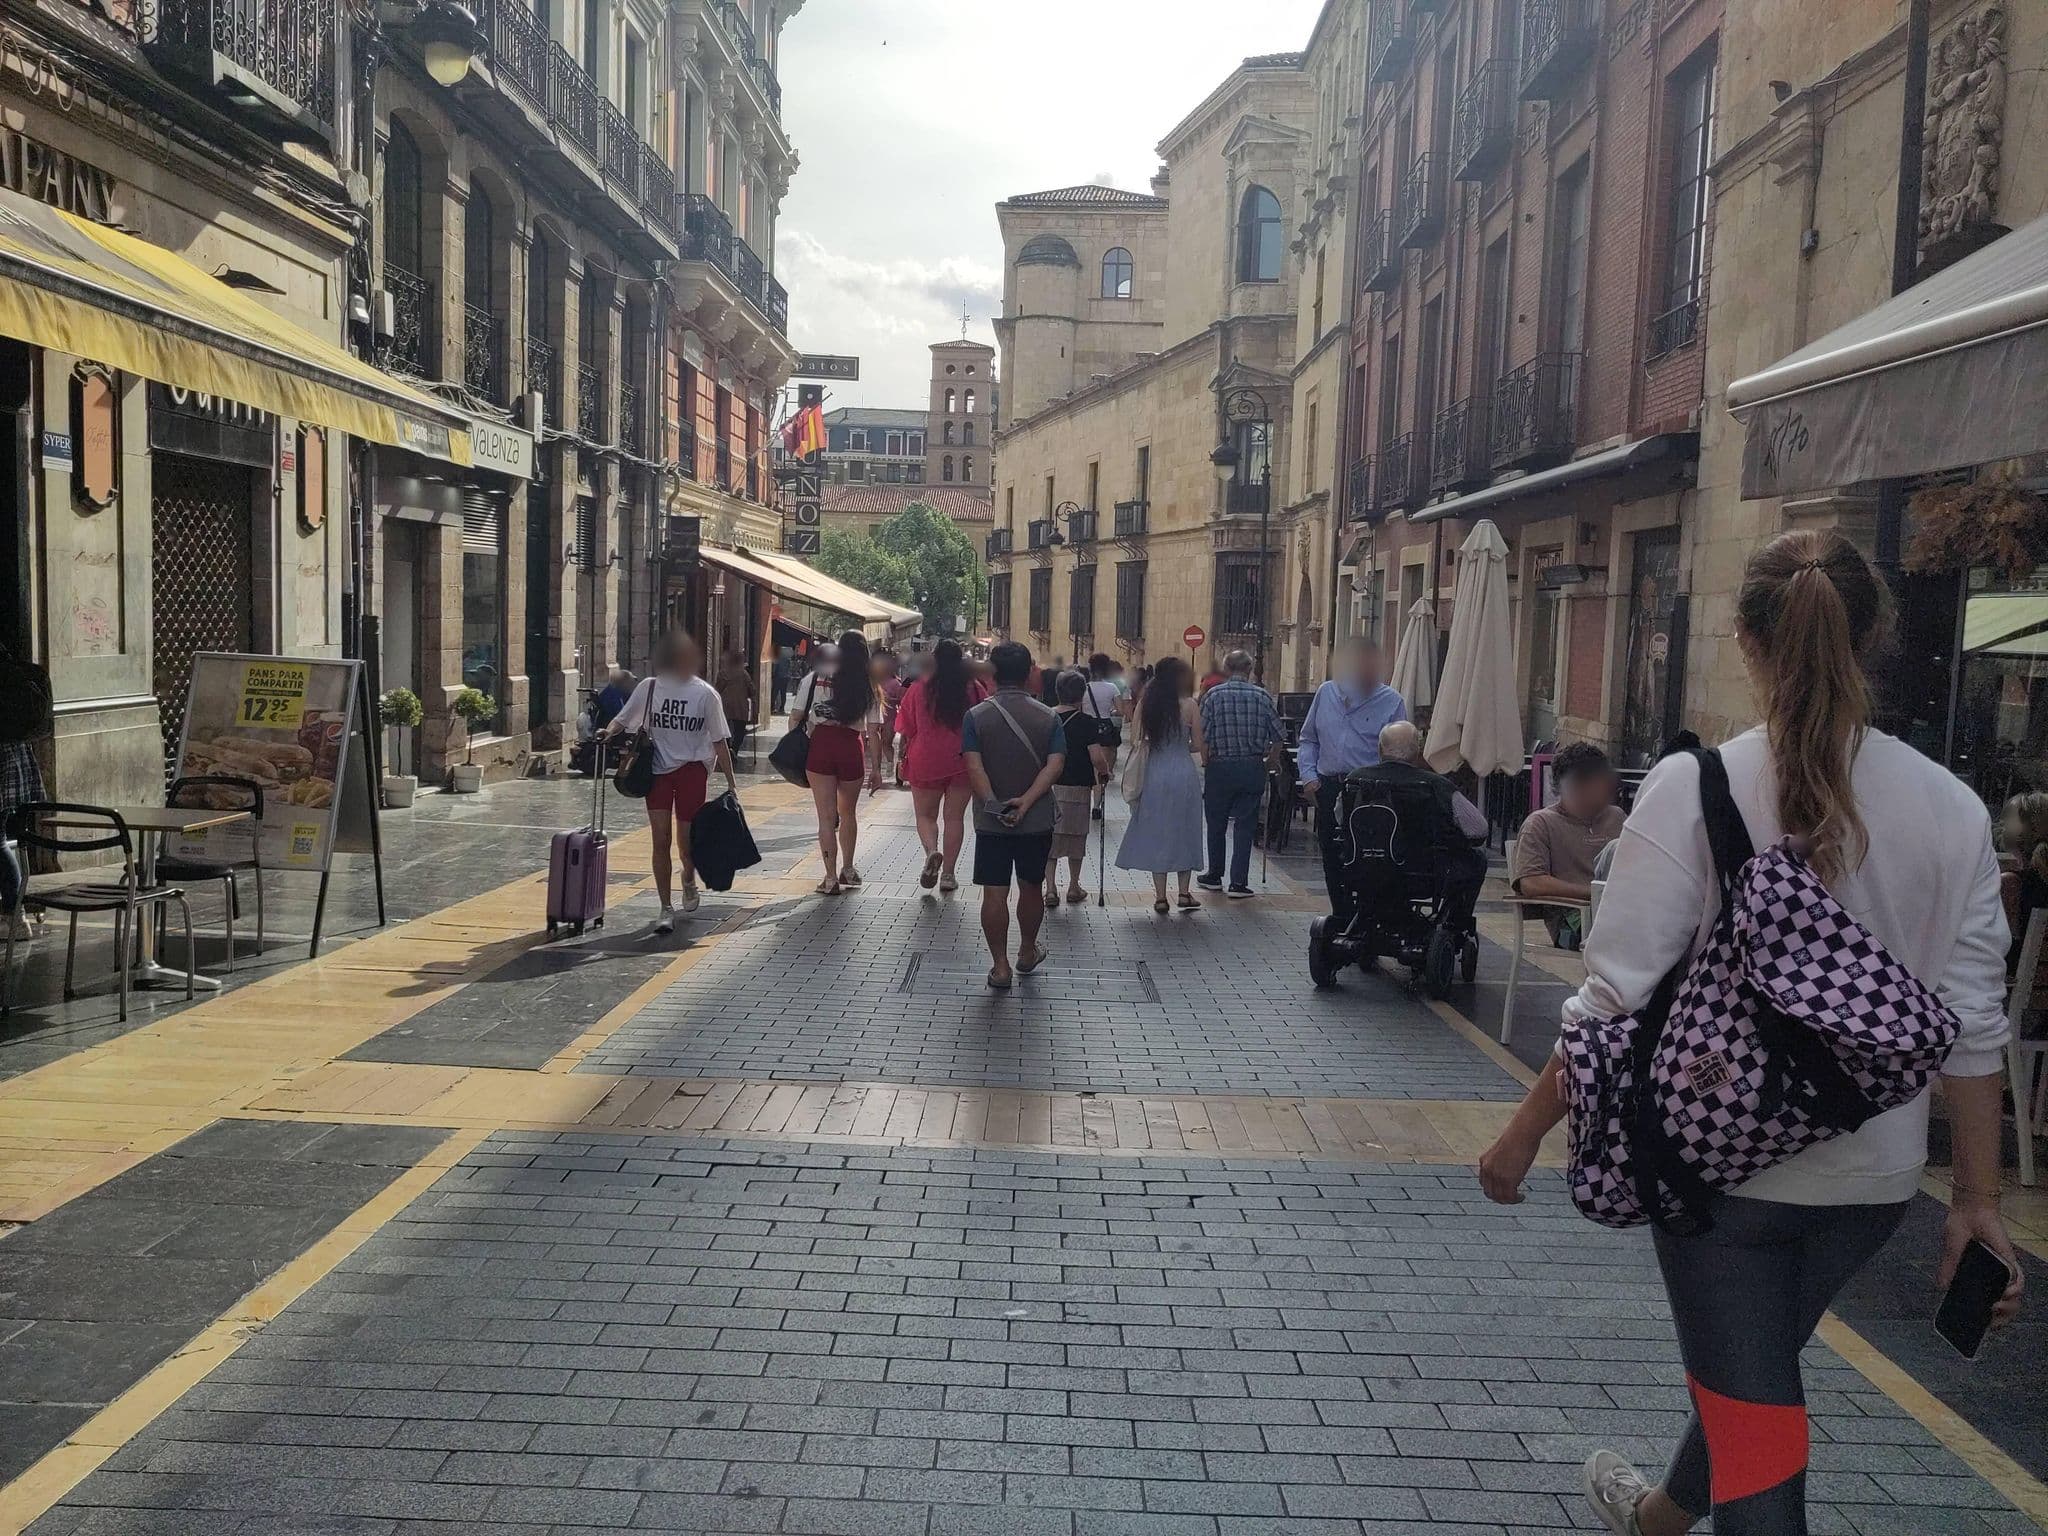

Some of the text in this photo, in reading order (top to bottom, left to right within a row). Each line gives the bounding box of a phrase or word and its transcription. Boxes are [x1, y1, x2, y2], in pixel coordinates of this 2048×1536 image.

[249, 668, 304, 680] PANS PARA
[247, 677, 304, 689] COMPARTIR
[661, 698, 688, 715] ART
